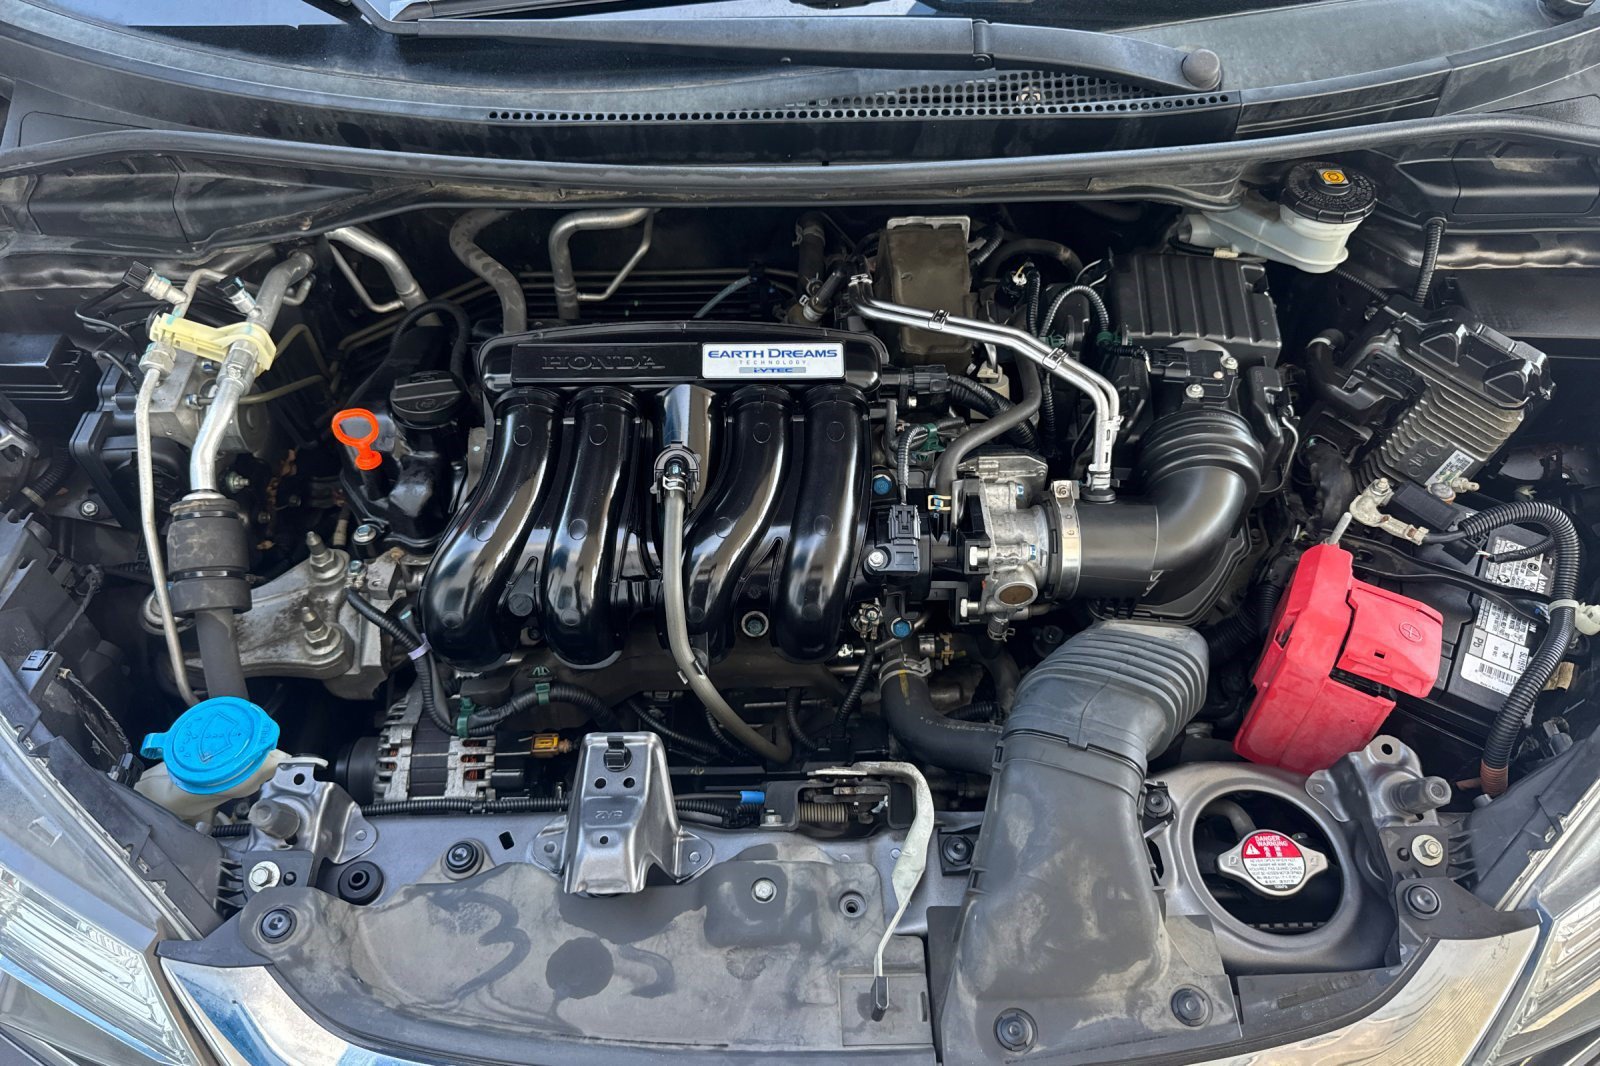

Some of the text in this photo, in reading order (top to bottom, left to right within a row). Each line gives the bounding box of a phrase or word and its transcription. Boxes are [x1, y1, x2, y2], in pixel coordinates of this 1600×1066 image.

[708, 348, 838, 359] EARTH DREAMS
[541, 356, 666, 370] HONDA
[1473, 636, 1484, 648] Pb
